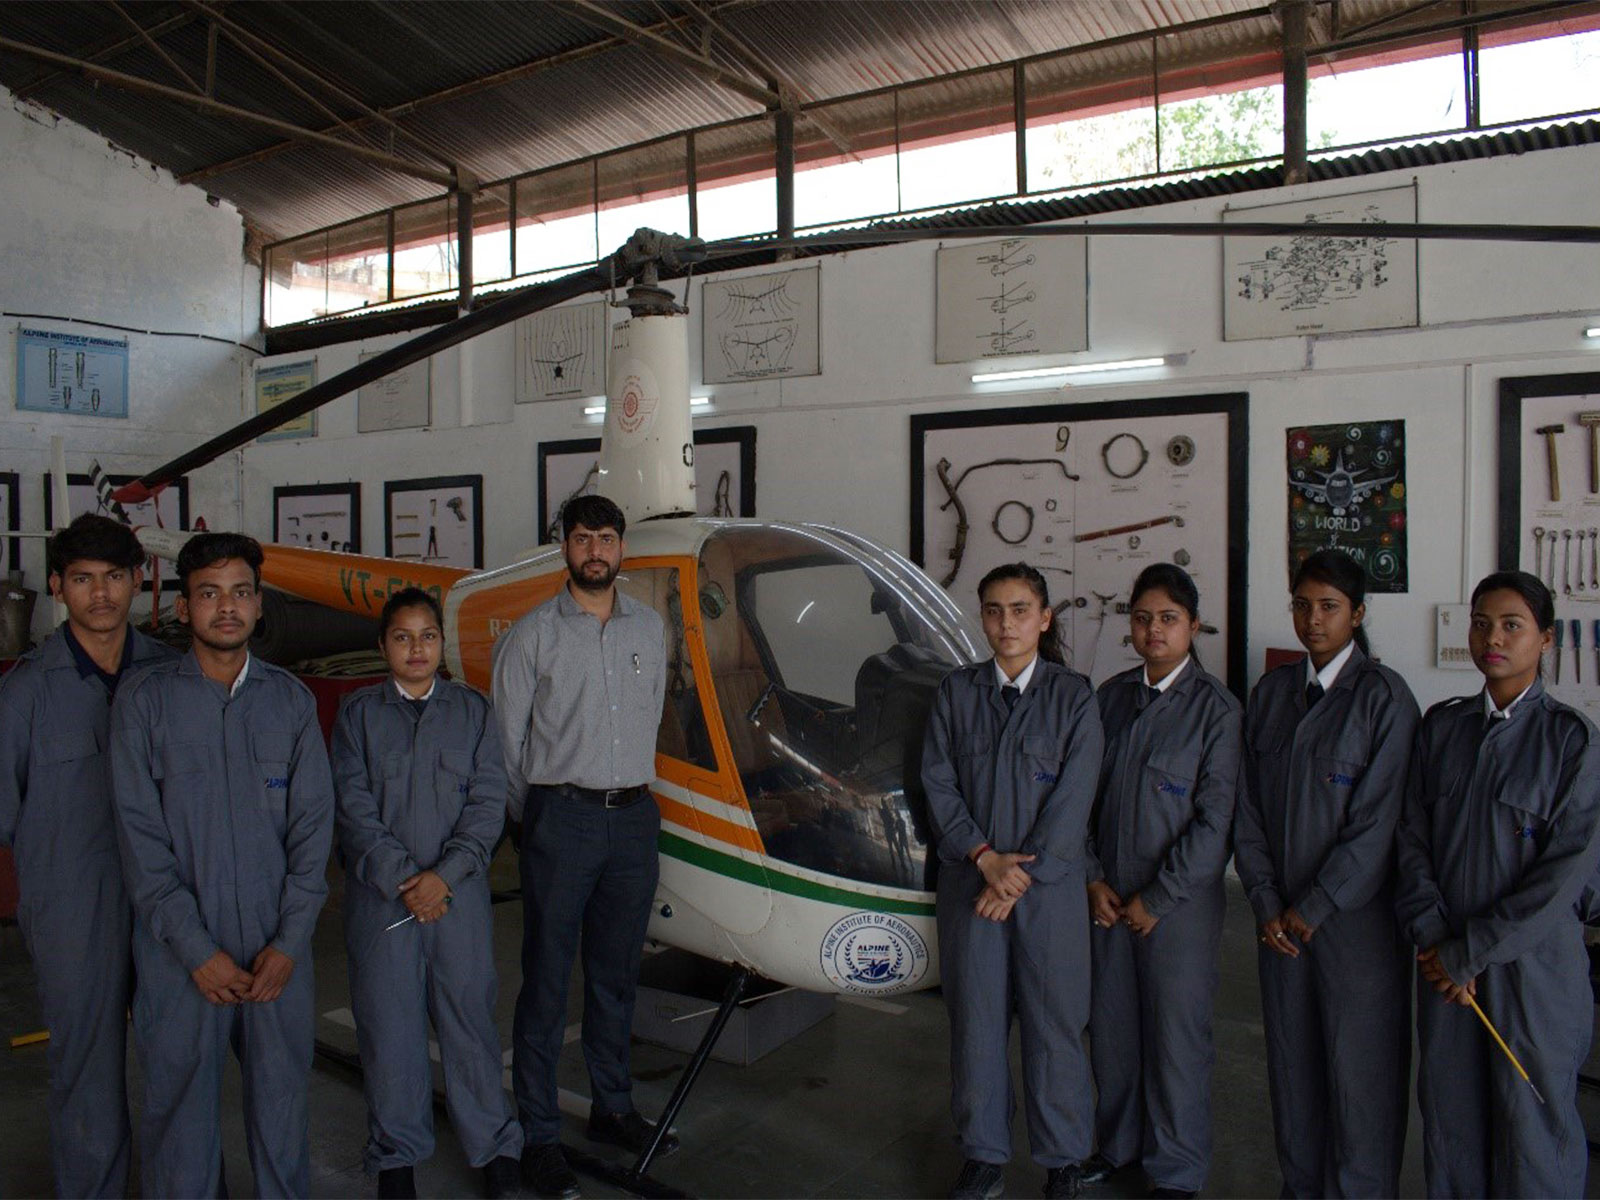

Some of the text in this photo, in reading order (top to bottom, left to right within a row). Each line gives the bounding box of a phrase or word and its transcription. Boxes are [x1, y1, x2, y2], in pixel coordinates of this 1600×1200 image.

[23, 329, 49, 339] ALPINE
[50, 333, 80, 343] INSTITUTE
[1056, 426, 1070, 452] 9
[1315, 516, 1361, 532] WORLD
[824, 915, 925, 959] ALPINE INSTITUTE OF AERONAUTICS
